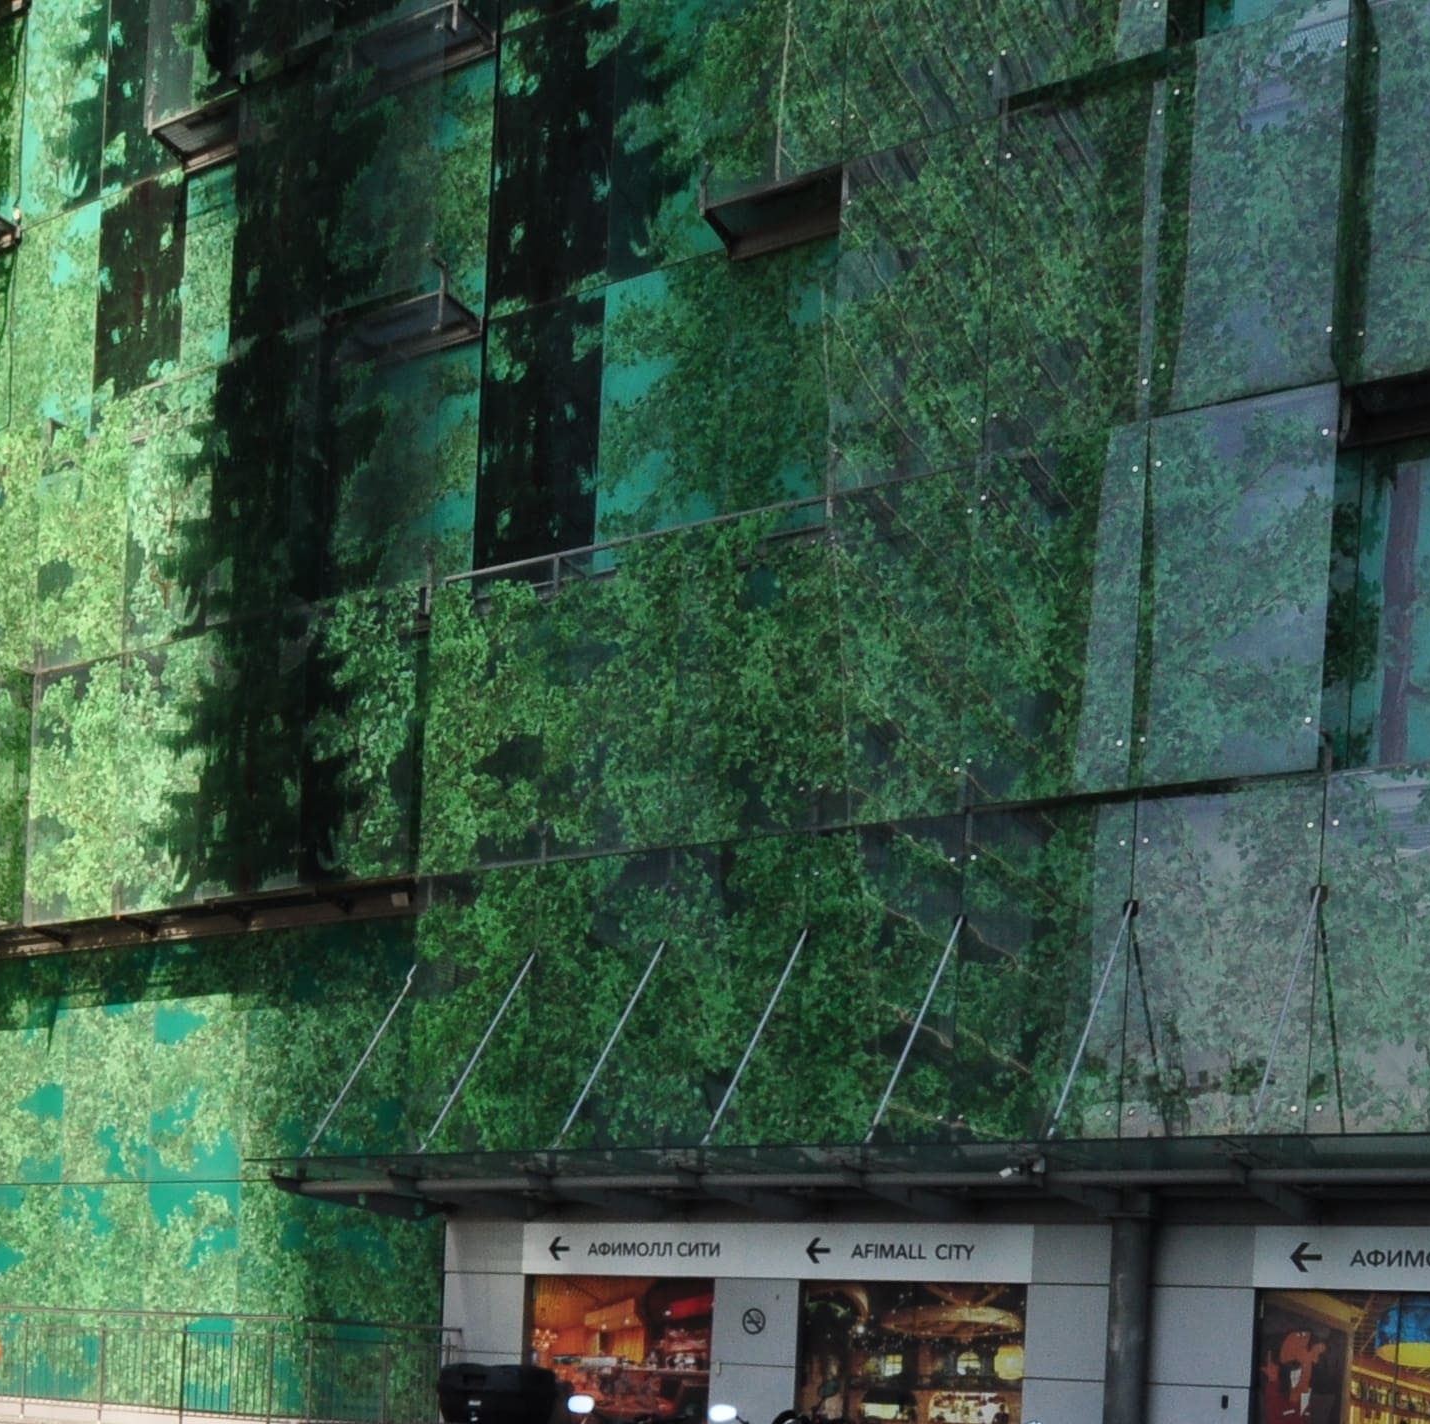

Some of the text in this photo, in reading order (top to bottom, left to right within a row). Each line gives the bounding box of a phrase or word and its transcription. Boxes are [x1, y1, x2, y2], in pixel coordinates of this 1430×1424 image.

[587, 1241, 721, 1258] АФИМОЛЛ СИТИ
[850, 1243, 975, 1260] AFIMALL CITY
